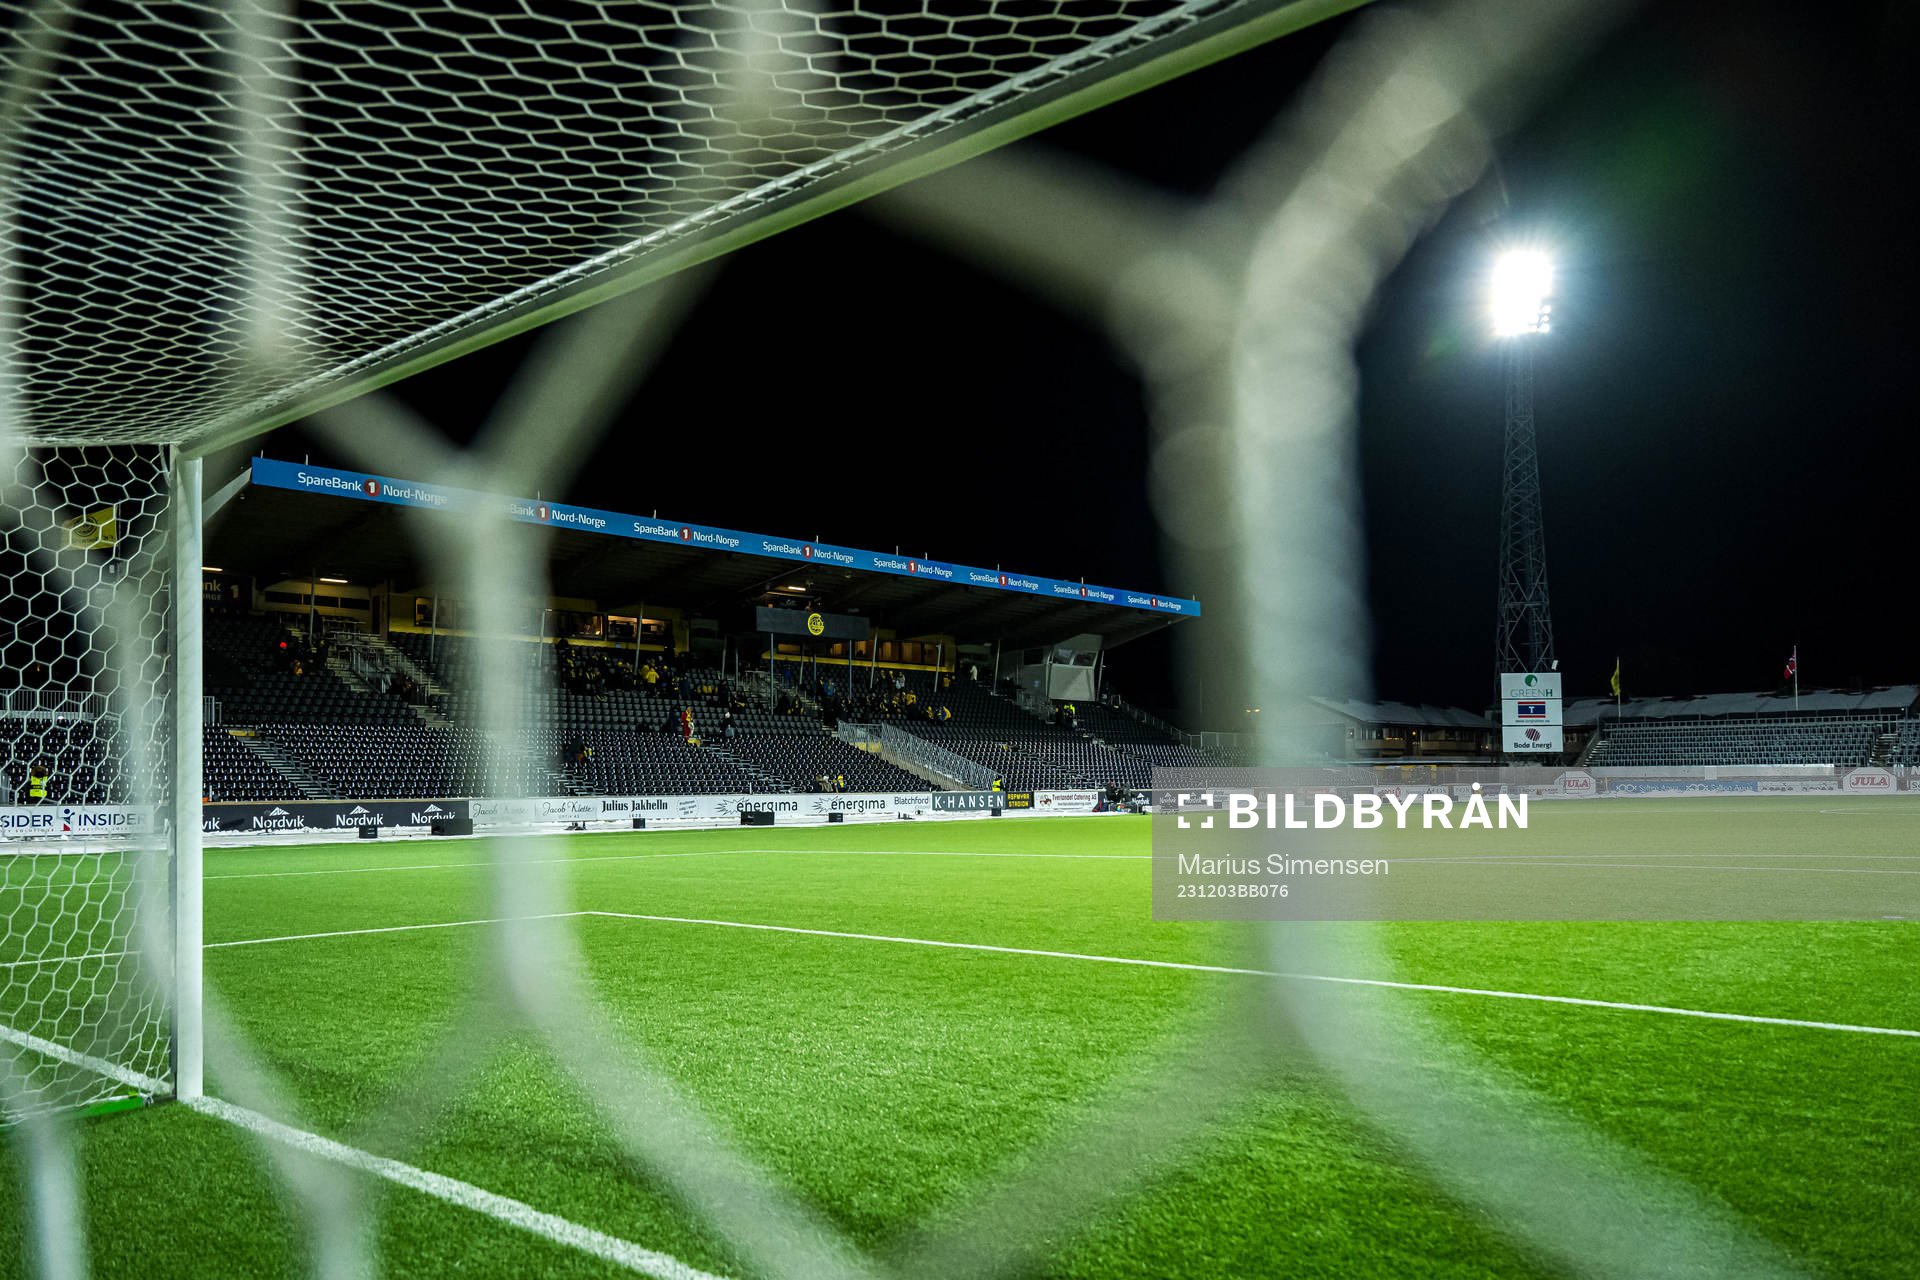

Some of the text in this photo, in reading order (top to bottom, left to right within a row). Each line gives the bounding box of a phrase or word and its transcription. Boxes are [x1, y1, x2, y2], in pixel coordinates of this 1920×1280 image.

[298, 472, 362, 492] SpareBank
[383, 485, 448, 505] Nord-Norge
[552, 510, 606, 528] Nord-Norge
[634, 522, 679, 539] SpareBank
[693, 531, 739, 547] Nord-Norge
[763, 541, 802, 556] SpareBank
[814, 549, 854, 564] Nord-Norge
[873, 557, 907, 570] SpareBank
[918, 564, 952, 578] Nord-Norge
[969, 572, 999, 584] SpareBank
[1008, 577, 1039, 590] Nord-Norge
[1053, 584, 1080, 596] SpareBank
[1087, 588, 1115, 601] Nord-Norge
[1127, 595, 1151, 606] SpareBank
[1157, 600, 1182, 611] Nord-Norge
[1510, 688, 1553, 697] GREENH
[1532, 741, 1552, 749] Energi
[1851, 776, 1888, 787] JULA
[602, 799, 629, 813] Julius
[631, 799, 668, 812] Jakhelln
[736, 799, 798, 813] energima
[831, 799, 886, 813] energima
[894, 796, 929, 805] Blatchford
[542, 801, 566, 817] Jacob
[252, 814, 305, 829] Nordvik
[335, 812, 384, 826] Nordvik
